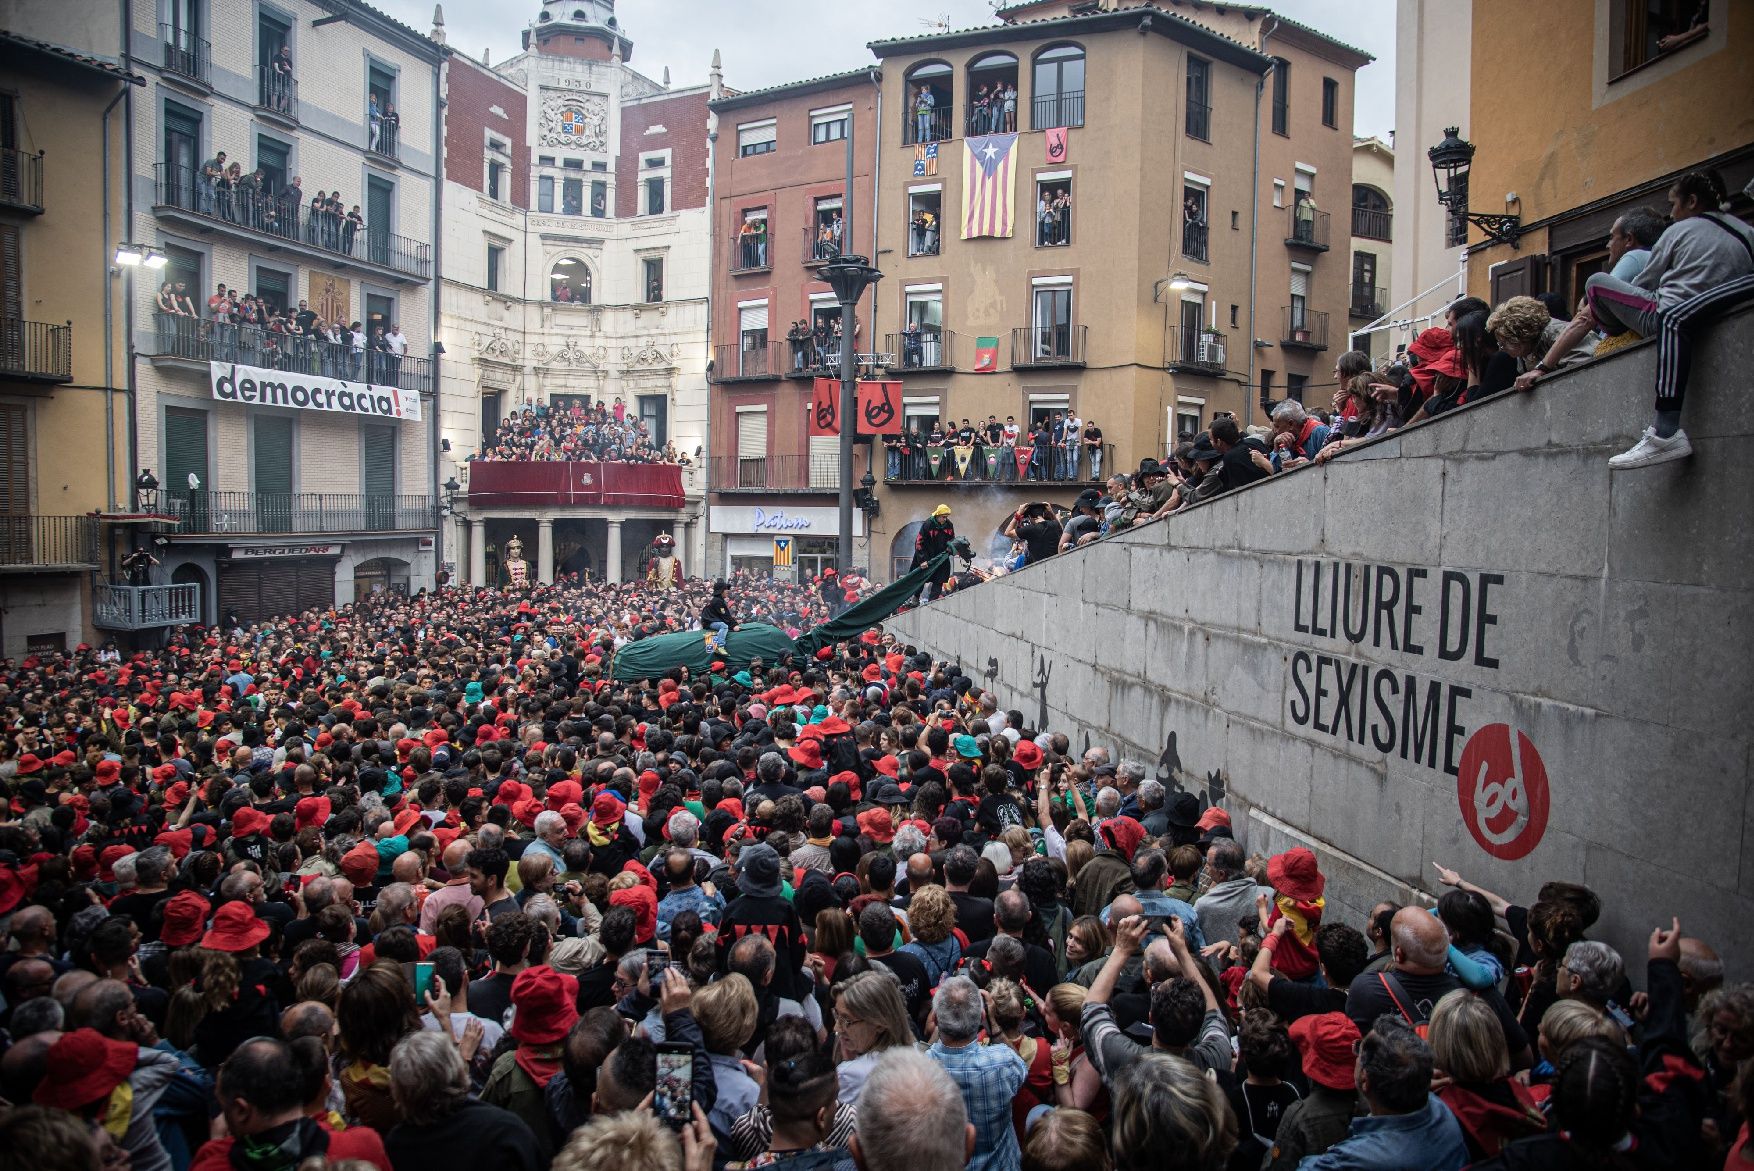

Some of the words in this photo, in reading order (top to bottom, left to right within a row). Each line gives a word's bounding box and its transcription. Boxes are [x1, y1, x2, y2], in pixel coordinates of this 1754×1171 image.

[216, 364, 401, 417] democràcia!
[754, 507, 812, 532] Patum
[1293, 558, 1428, 656] LLIURE
[1437, 569, 1505, 670] DE
[1289, 650, 1473, 777] SEXISME
